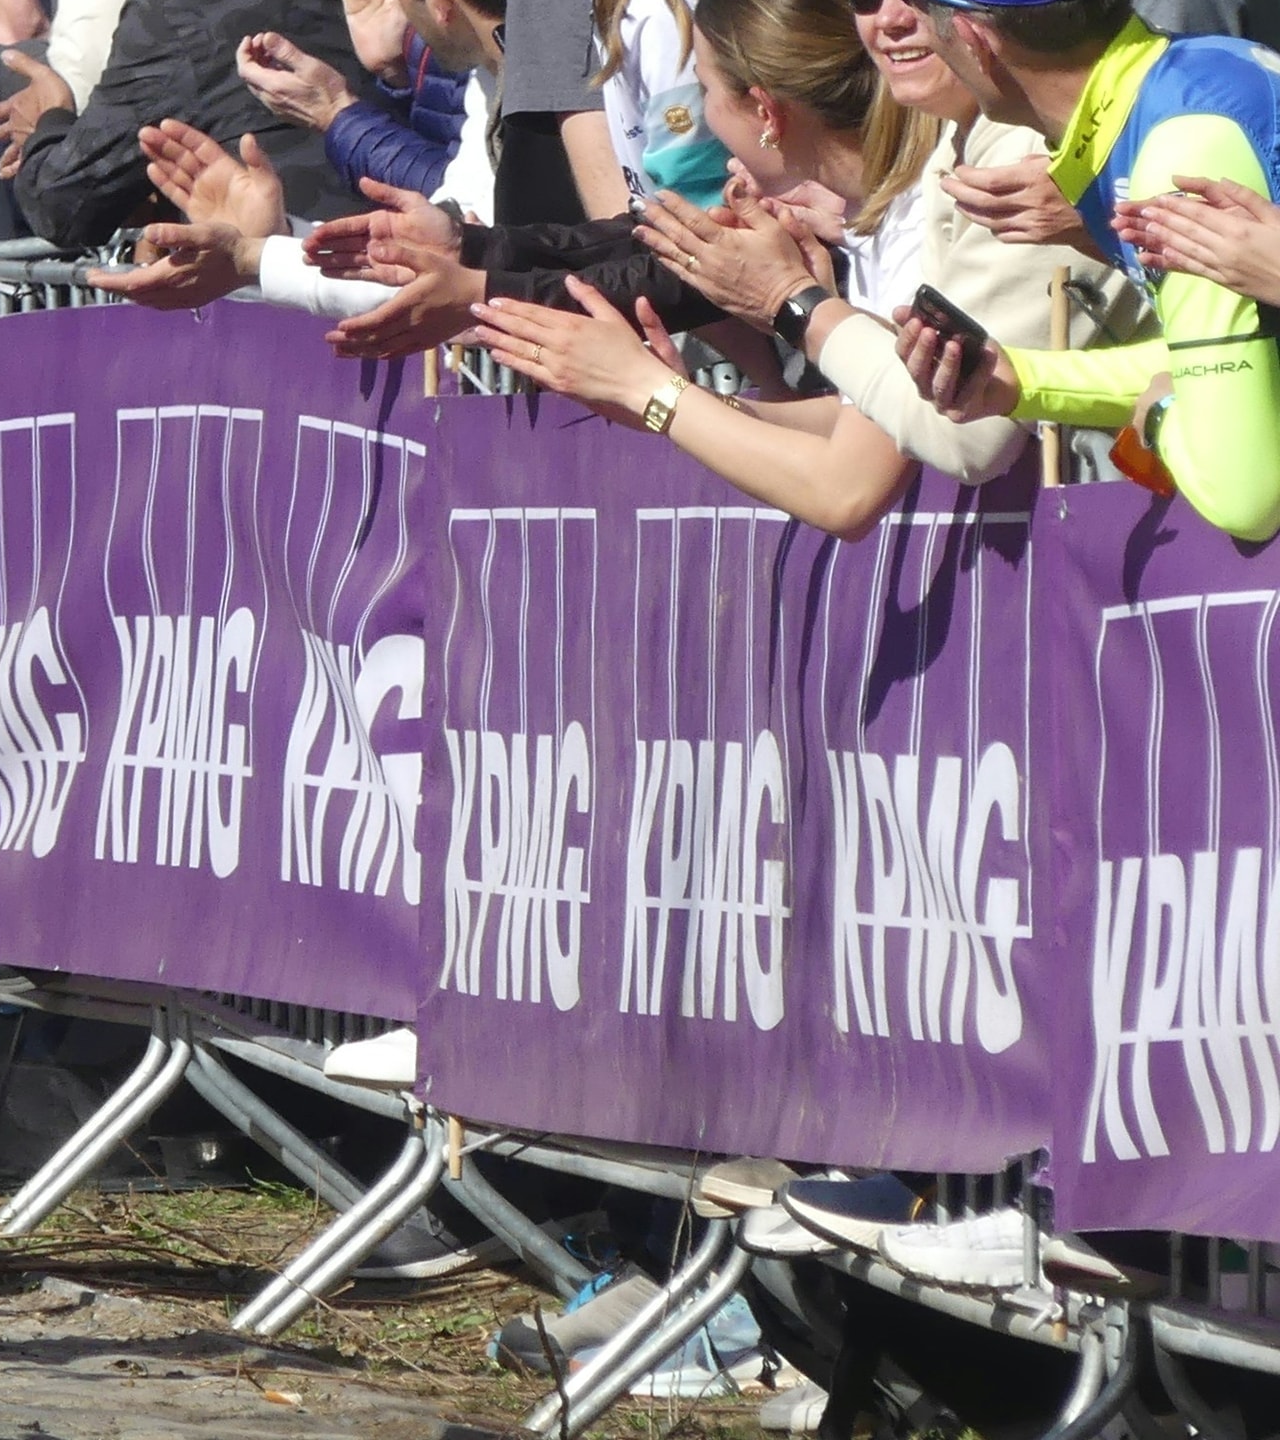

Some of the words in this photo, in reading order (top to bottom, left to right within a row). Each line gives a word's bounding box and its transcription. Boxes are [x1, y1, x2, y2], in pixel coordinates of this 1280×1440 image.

[95, 606, 256, 879] KPMG
[439, 720, 590, 1012] KPMG
[619, 728, 790, 1032] KPMG
[826, 740, 1030, 1054] KPMG
[1081, 847, 1280, 1164] KPM
